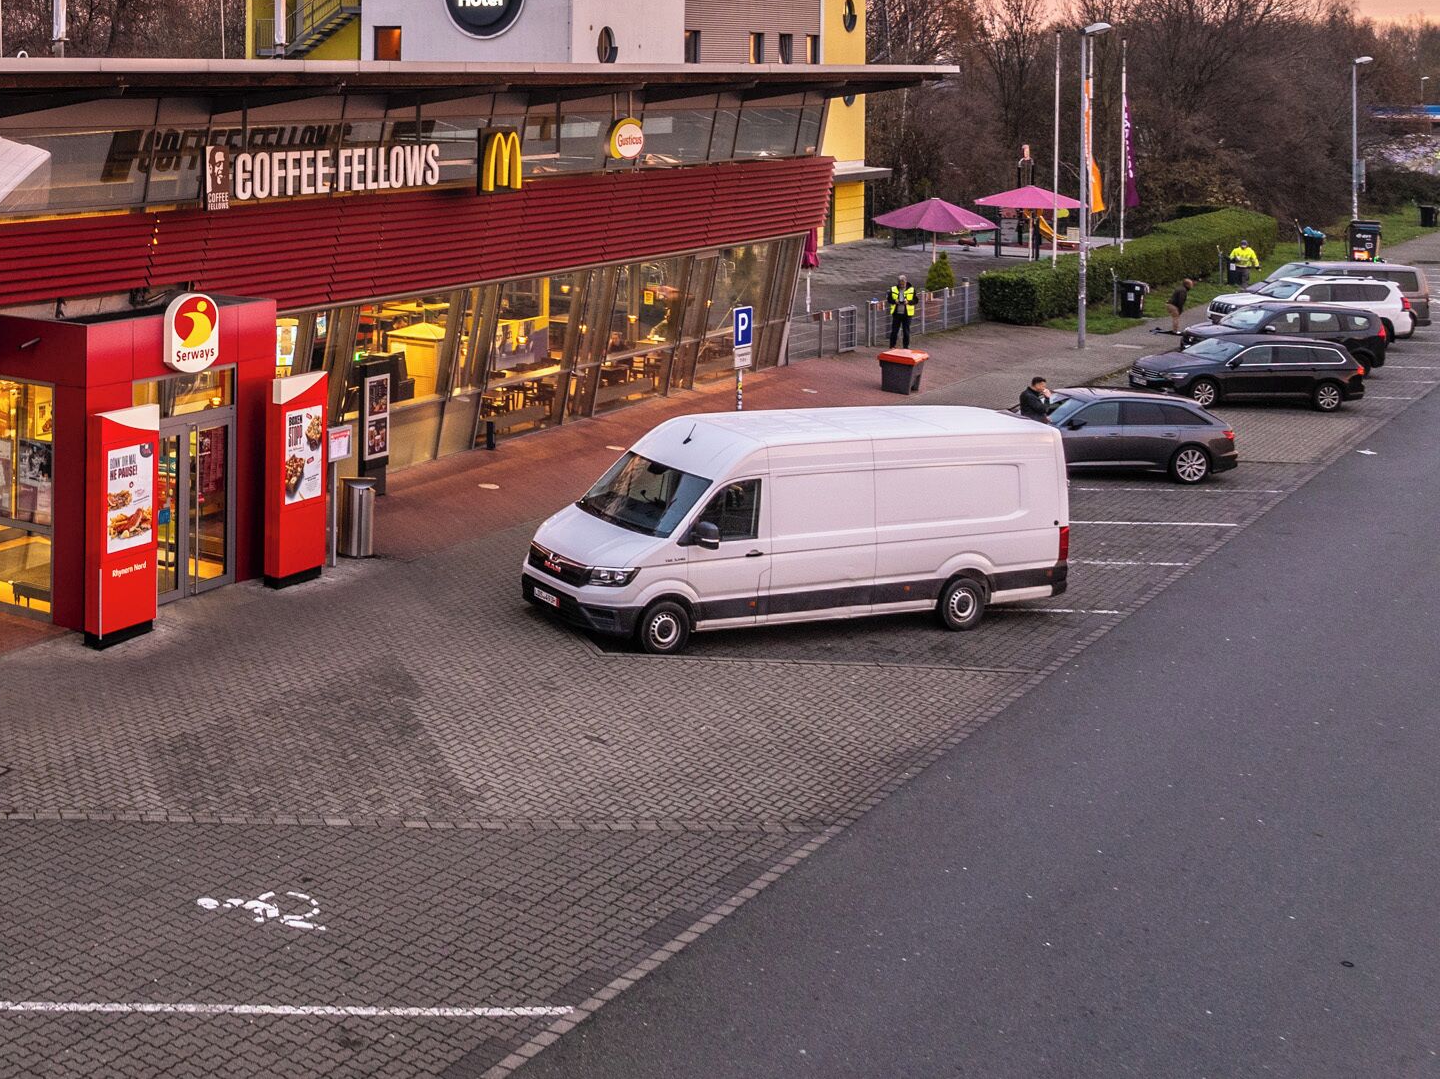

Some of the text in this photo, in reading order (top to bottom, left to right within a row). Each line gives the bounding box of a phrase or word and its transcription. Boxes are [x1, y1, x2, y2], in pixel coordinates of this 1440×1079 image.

[235, 143, 440, 200] COFFEE FELLOWS
[207, 192, 229, 203] COFFEE
[207, 202, 229, 210] FELLOWS
[738, 312, 748, 341] P
[176, 348, 215, 362] Serways
[112, 560, 147, 577] Rhynern Nord
